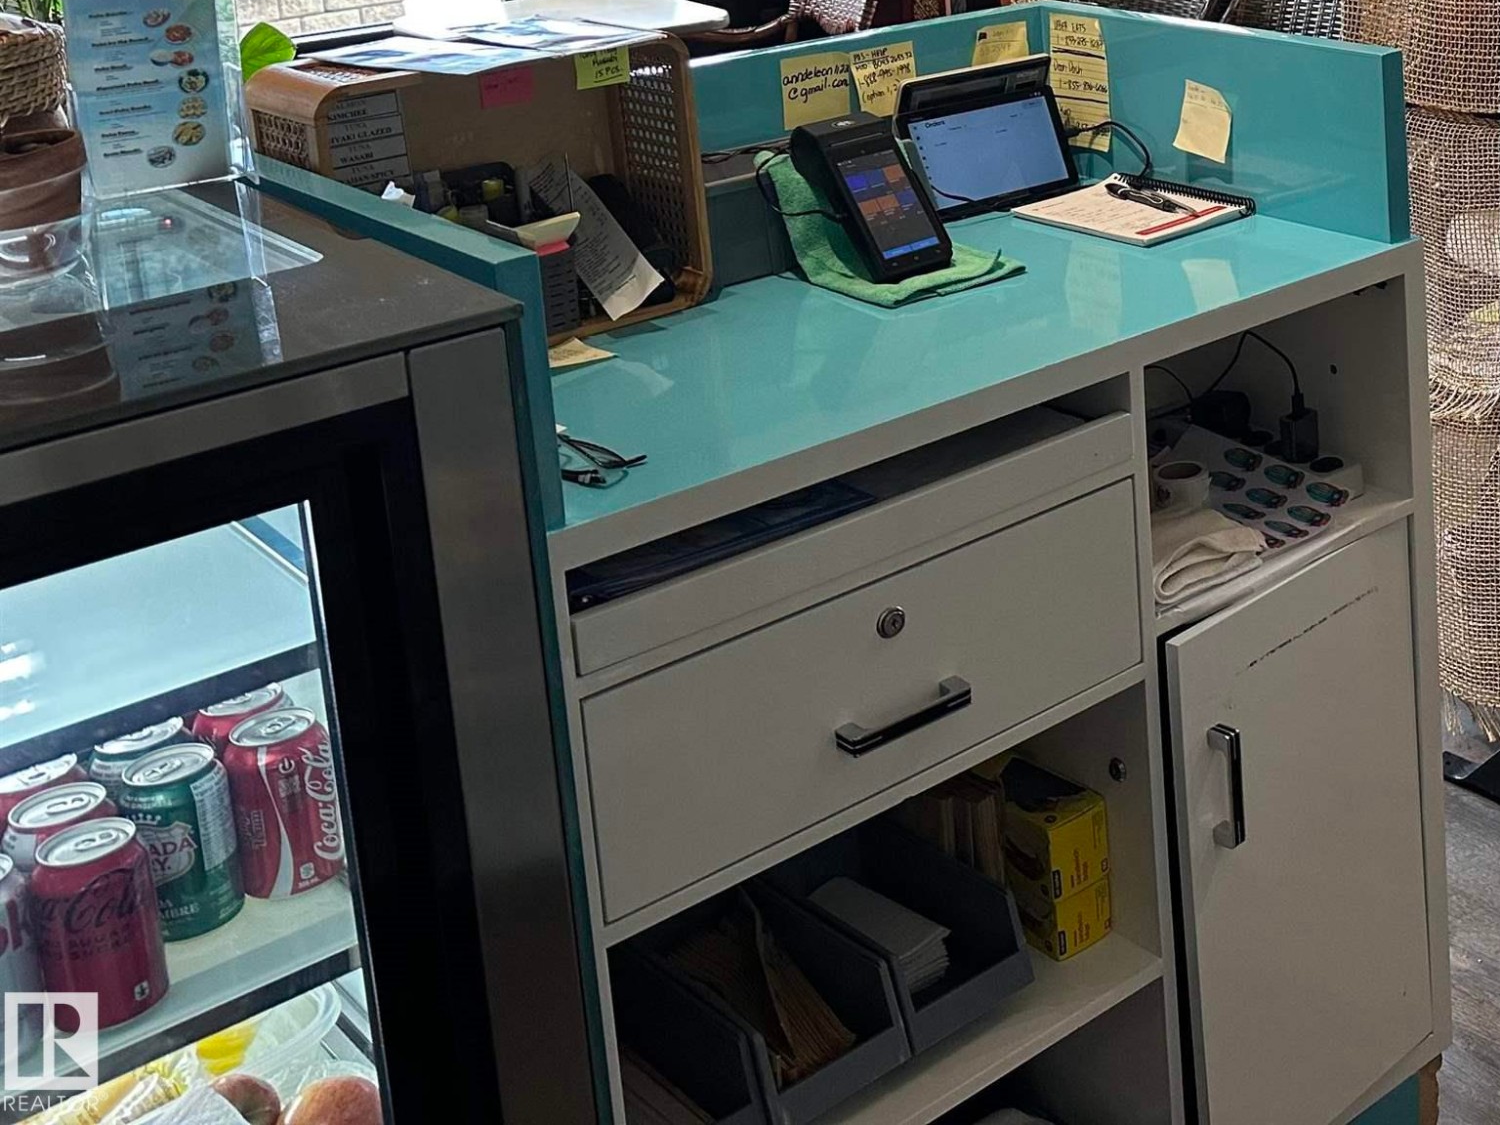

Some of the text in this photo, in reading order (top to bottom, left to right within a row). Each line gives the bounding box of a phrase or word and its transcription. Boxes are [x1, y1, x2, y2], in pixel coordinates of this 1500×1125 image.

[1071, 23, 1086, 33] EATS
[925, 120, 945, 129] Orders
[340, 152, 374, 164] WASABI
